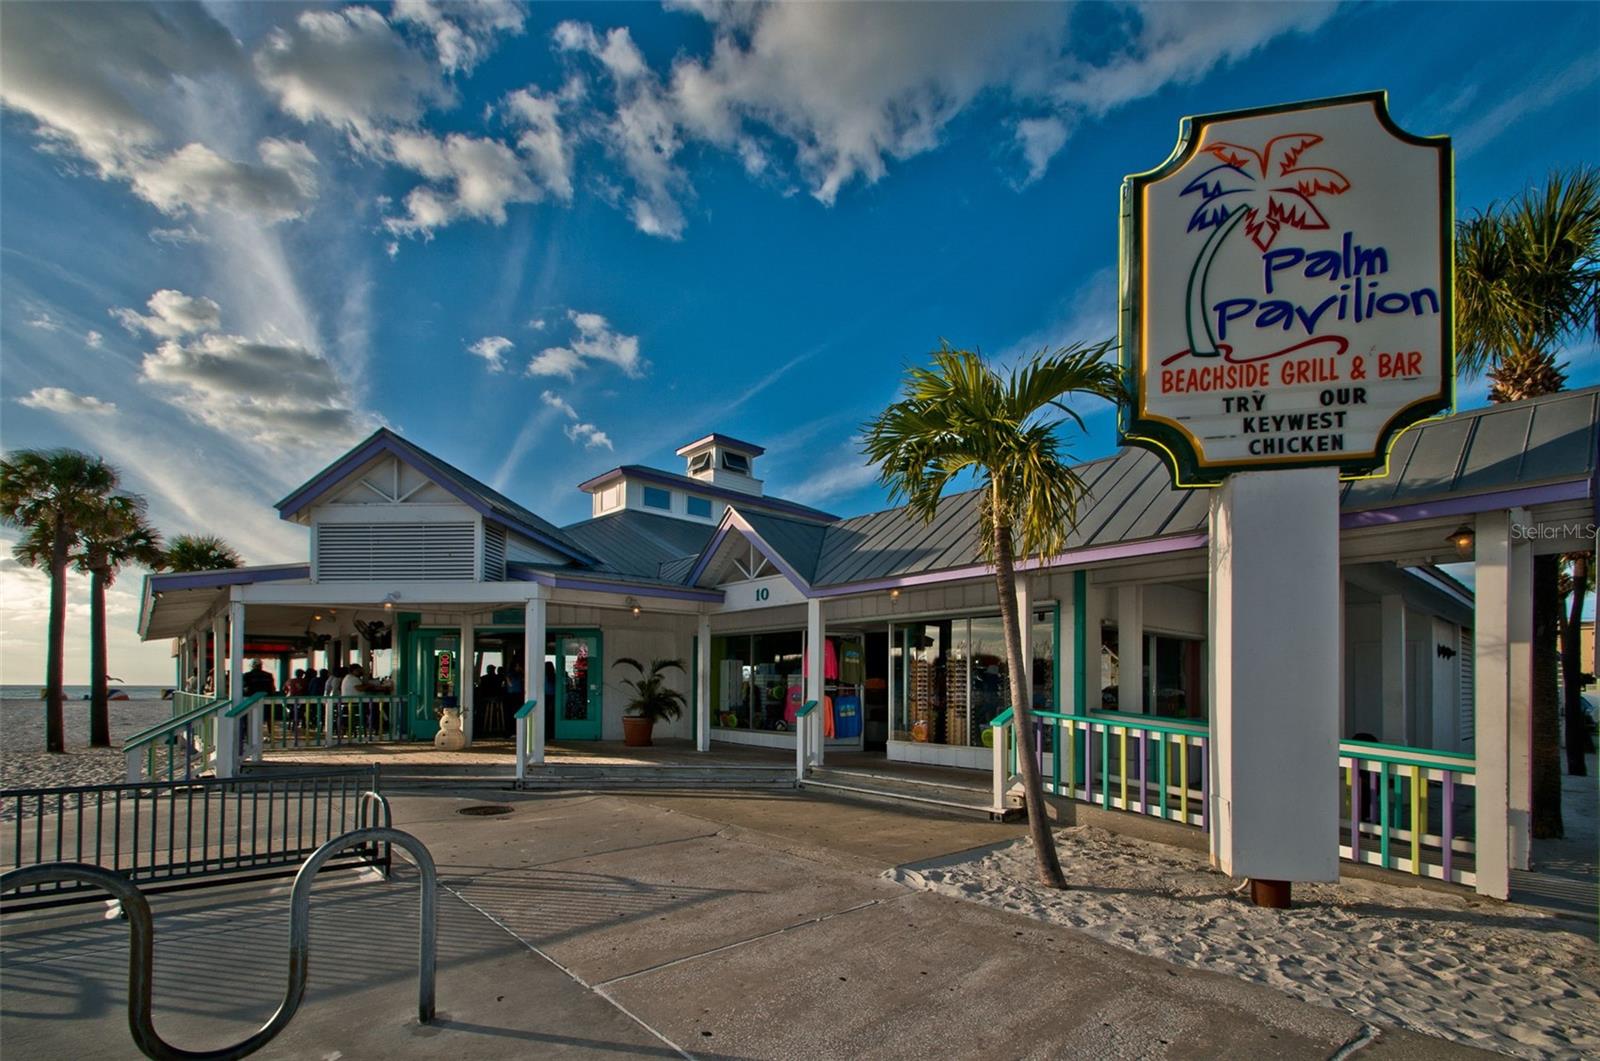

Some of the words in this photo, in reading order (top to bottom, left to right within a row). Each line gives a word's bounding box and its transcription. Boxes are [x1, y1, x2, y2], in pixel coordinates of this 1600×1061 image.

[1161, 362, 1270, 394] BEACHSIDE
[1281, 357, 1340, 386] GRILL
[1350, 355, 1367, 381] &
[1378, 351, 1423, 378] BAR
[1222, 394, 1266, 414] TRY
[1319, 387, 1367, 407] OUR
[1243, 411, 1348, 434] KEYWEST
[1248, 434, 1344, 456] CHICKEN
[755, 587, 769, 602] 10
